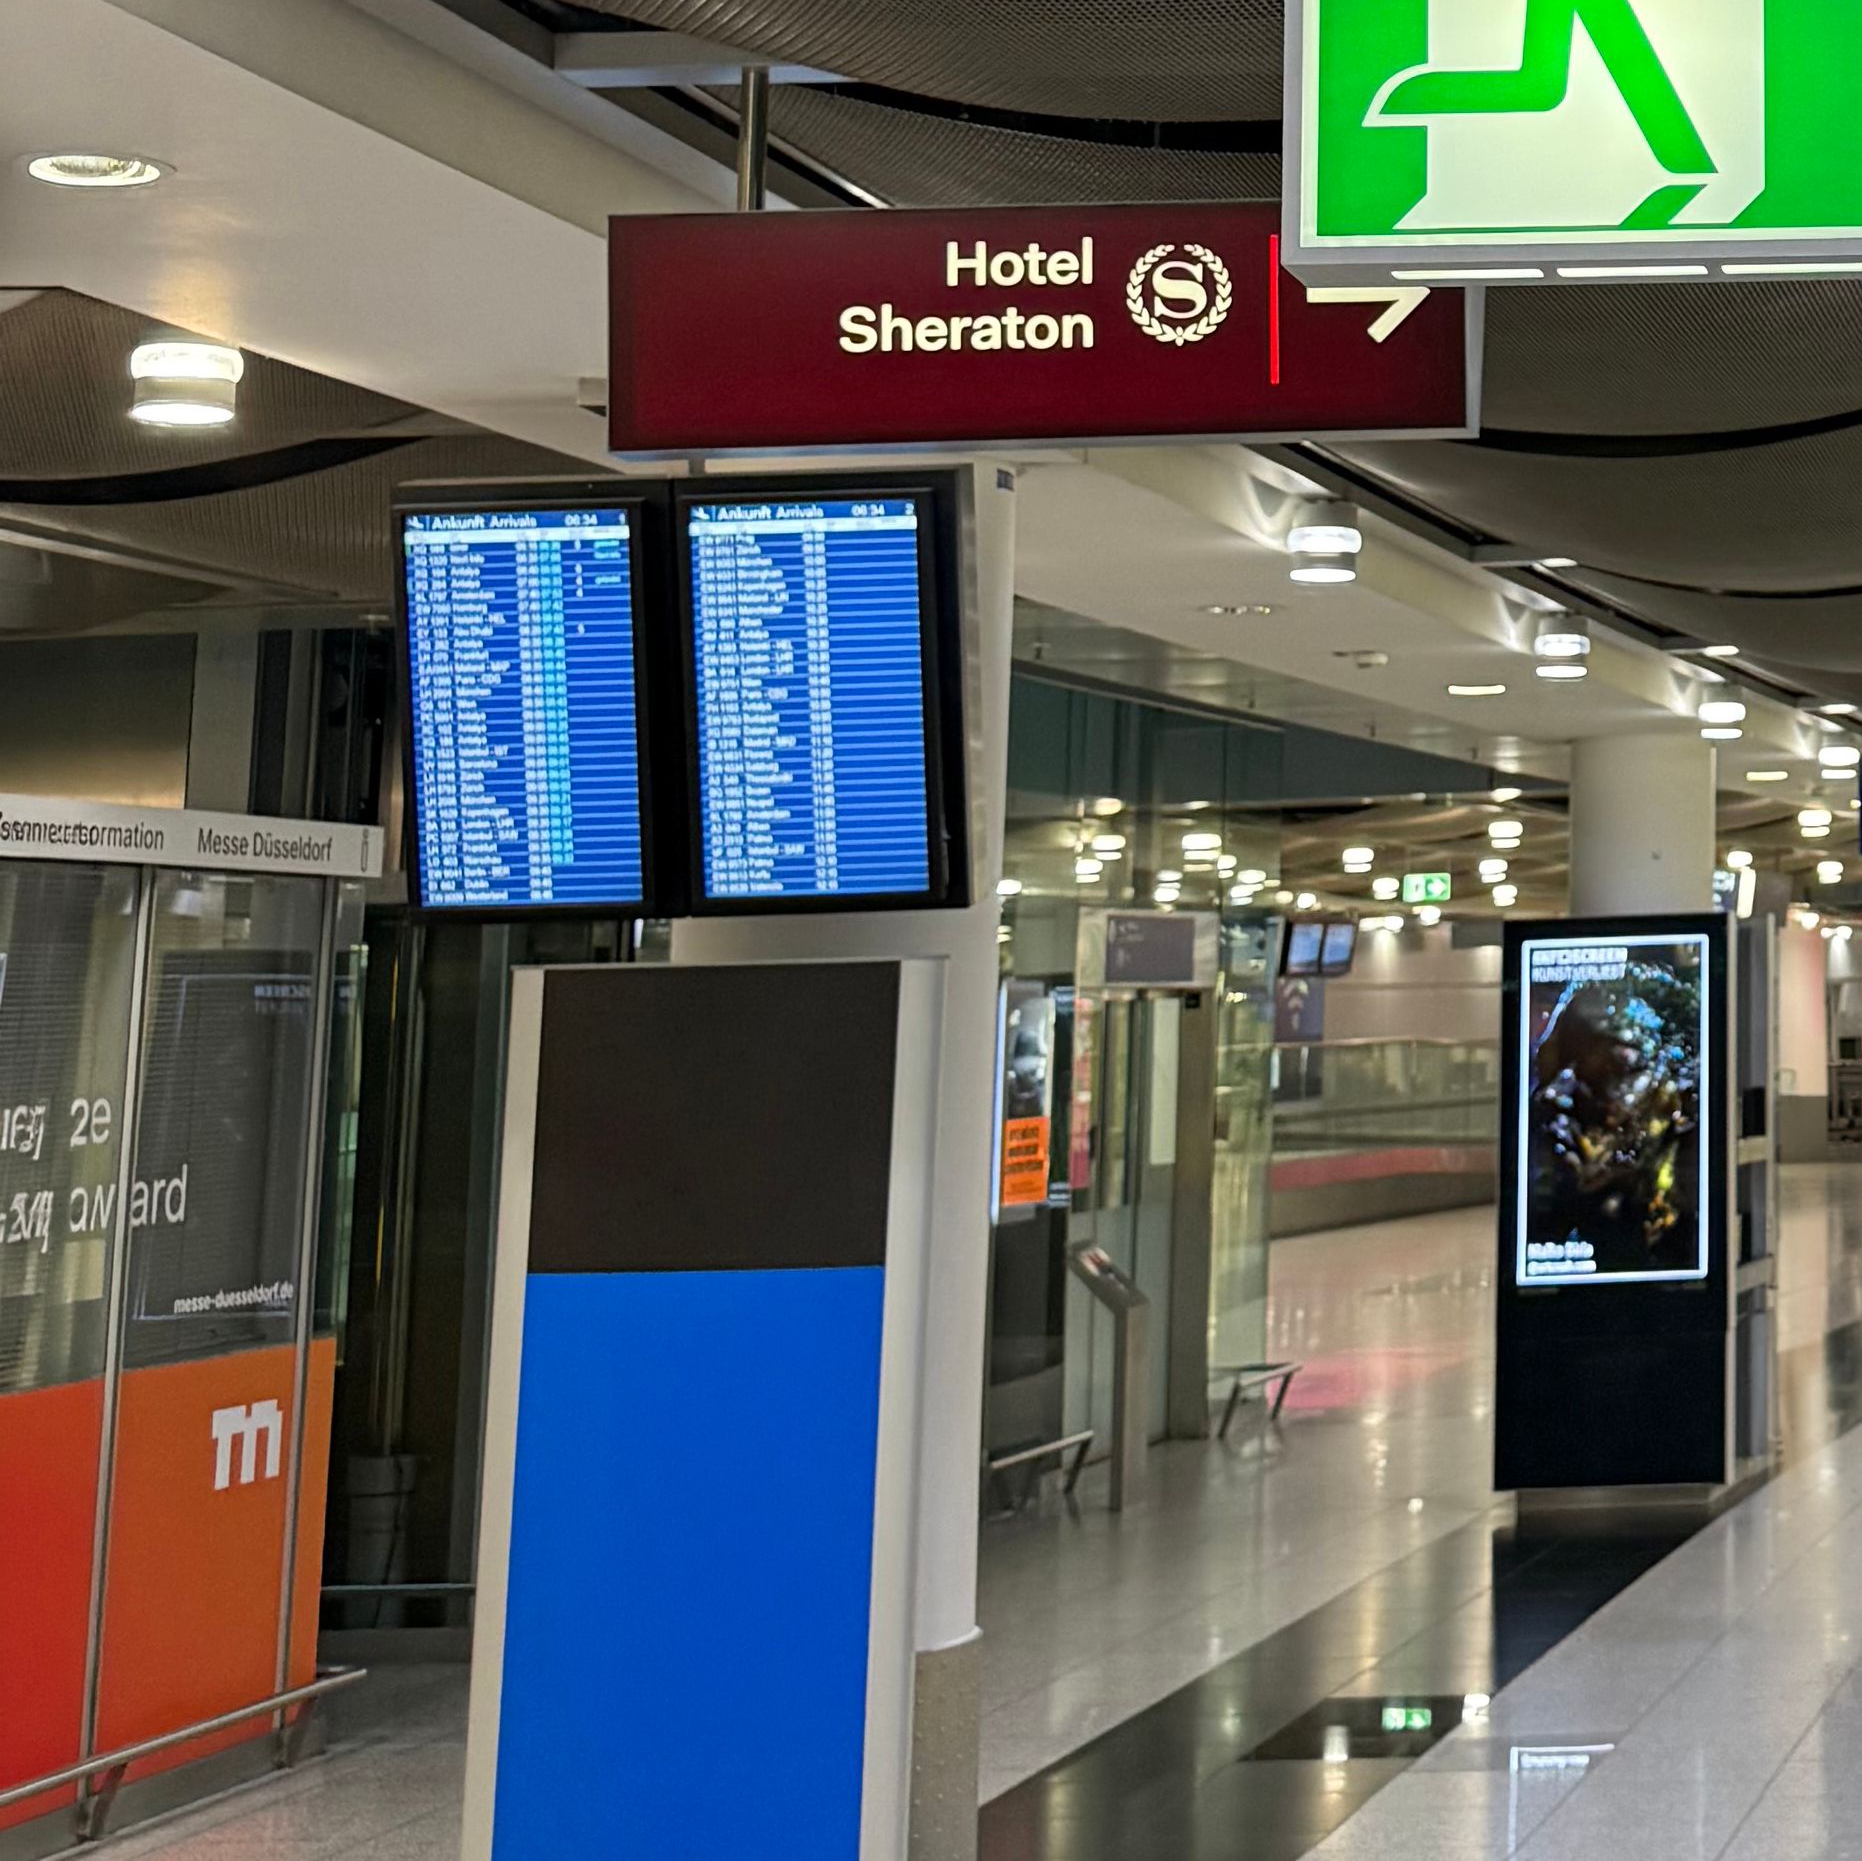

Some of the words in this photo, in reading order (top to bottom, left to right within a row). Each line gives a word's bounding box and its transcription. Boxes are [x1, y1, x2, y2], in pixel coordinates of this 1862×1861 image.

[946, 236, 1094, 287] Hotel
[839, 305, 1095, 354] Sheraton
[197, 827, 249, 856] Messe
[253, 831, 333, 862] Düsseldorf
